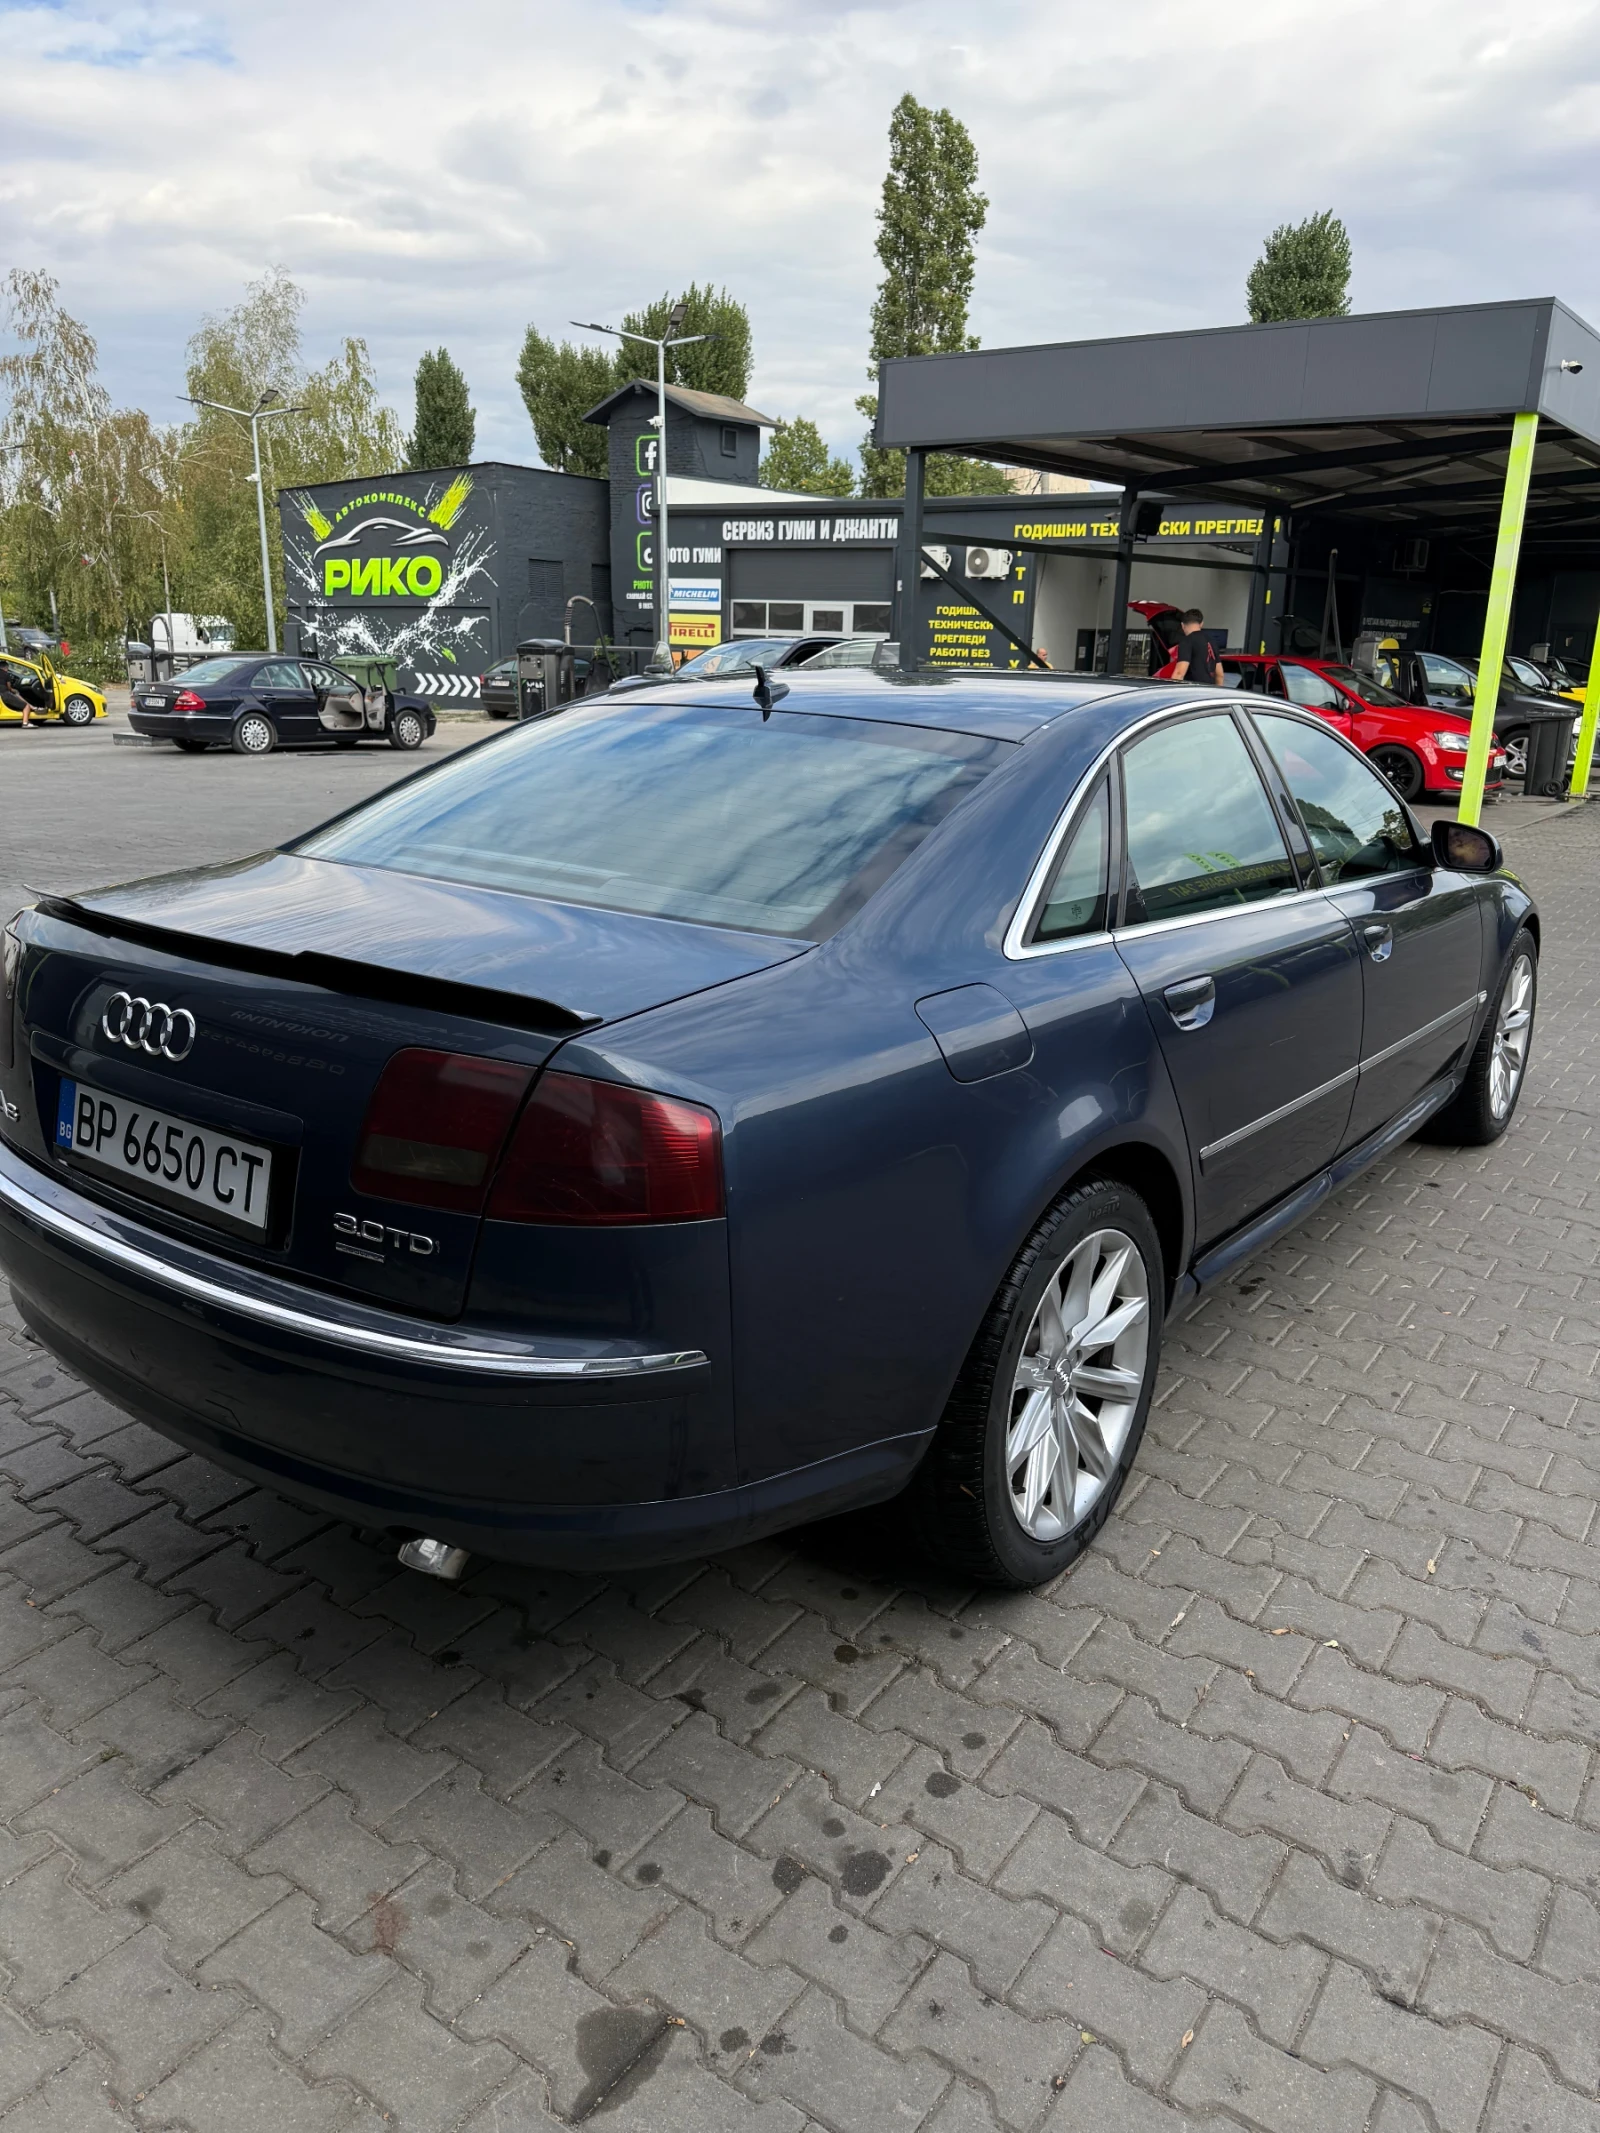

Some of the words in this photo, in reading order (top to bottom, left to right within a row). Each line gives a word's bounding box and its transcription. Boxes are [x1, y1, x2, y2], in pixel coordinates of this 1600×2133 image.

[722, 520, 774, 541] СЕРВИЗ
[778, 520, 816, 540] ГУМИ
[819, 520, 830, 539] И
[833, 518, 899, 542] ДЖАНТИ
[1013, 522, 1087, 540] ГОДИШНИ
[1090, 520, 1191, 538] ТЕХСКИ
[667, 547, 690, 564] ОТО
[692, 547, 722, 564] ГУМИ
[324, 555, 443, 597] РИКО
[673, 590, 719, 599] MICHELIN
[936, 606, 982, 617] ГОДИШН
[928, 620, 994, 630] ТЕХНИЧЕСКИ
[934, 634, 986, 645] ПРЕГЛЕДИ
[929, 647, 969, 658] РАБОТИ
[971, 649, 991, 658] БЕЗ
[59, 1120, 72, 1139] BG
[75, 1092, 118, 1153] BP
[123, 1113, 205, 1191] 6650
[212, 1146, 264, 1214] CT
